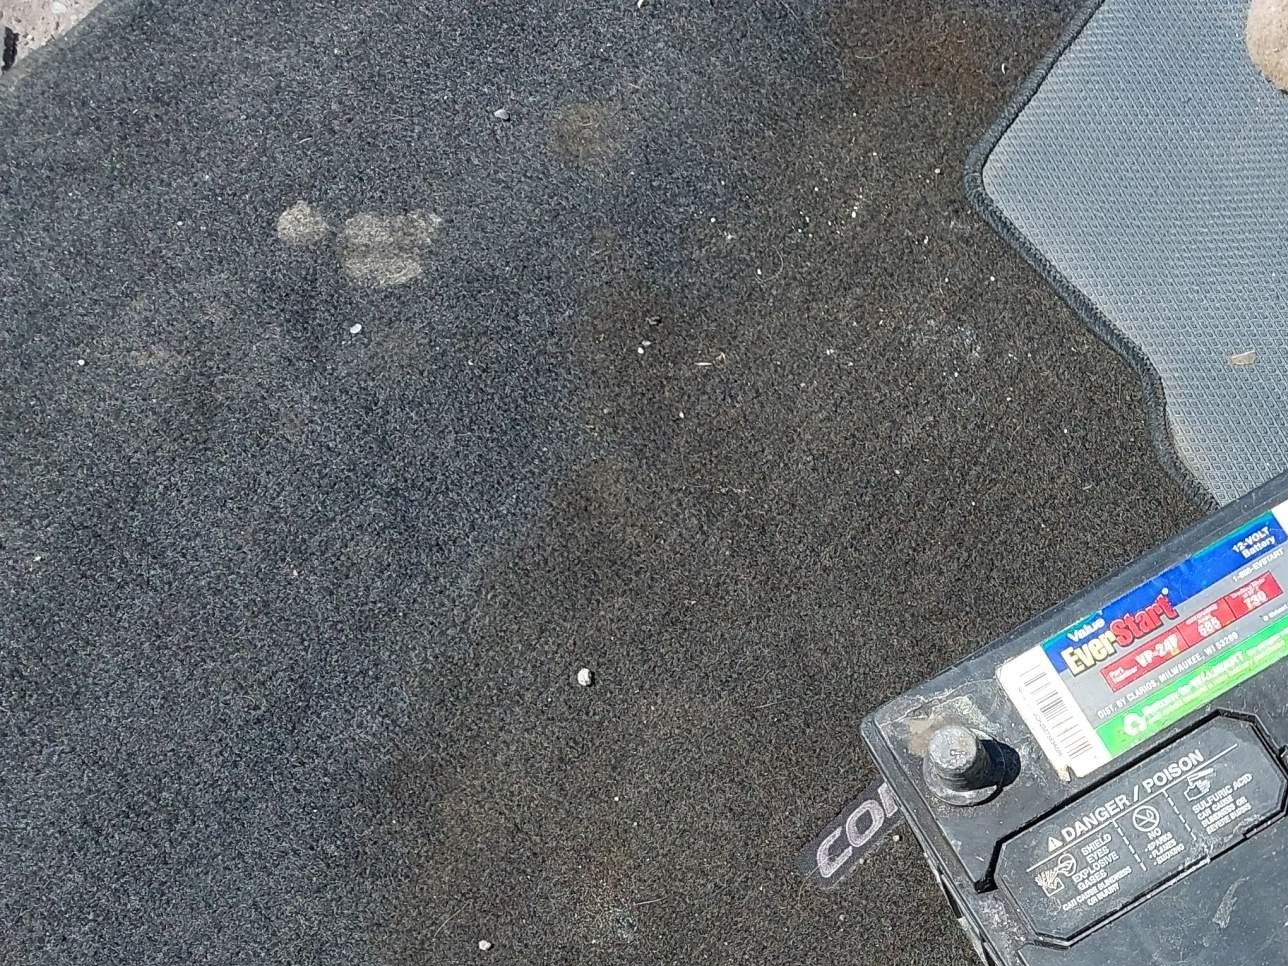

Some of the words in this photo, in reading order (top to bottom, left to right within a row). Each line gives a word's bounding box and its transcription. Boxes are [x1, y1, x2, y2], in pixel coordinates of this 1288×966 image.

[1231, 525, 1271, 553] 12-VOLT
[1241, 534, 1276, 559] Battery
[1059, 590, 1180, 678] EverStart
[1066, 614, 1106, 644] Value
[1115, 697, 1127, 708] BY
[1158, 651, 1205, 683] MILWAUKEE,
[1203, 644, 1216, 656] WI
[1060, 792, 1130, 842] DANGER
[1127, 784, 1144, 802] /
[1141, 748, 1204, 793] POISON
[1191, 784, 1233, 814] SULFURIC
[1230, 771, 1254, 790] ACID
[1235, 795, 1248, 807] OR
[1196, 807, 1213, 820] CAN
[1211, 794, 1234, 812] CAUSE
[1079, 832, 1112, 856] SHIELD
[1146, 827, 1162, 840] NO
[1146, 831, 1173, 851] SPARKS
[1085, 845, 1110, 864] EYES
[1151, 838, 1177, 857] FLAMES
[1071, 850, 1119, 884] EXPLOSIVE
[1076, 868, 1108, 891] GASES
[1075, 885, 1098, 903] CAUSE
